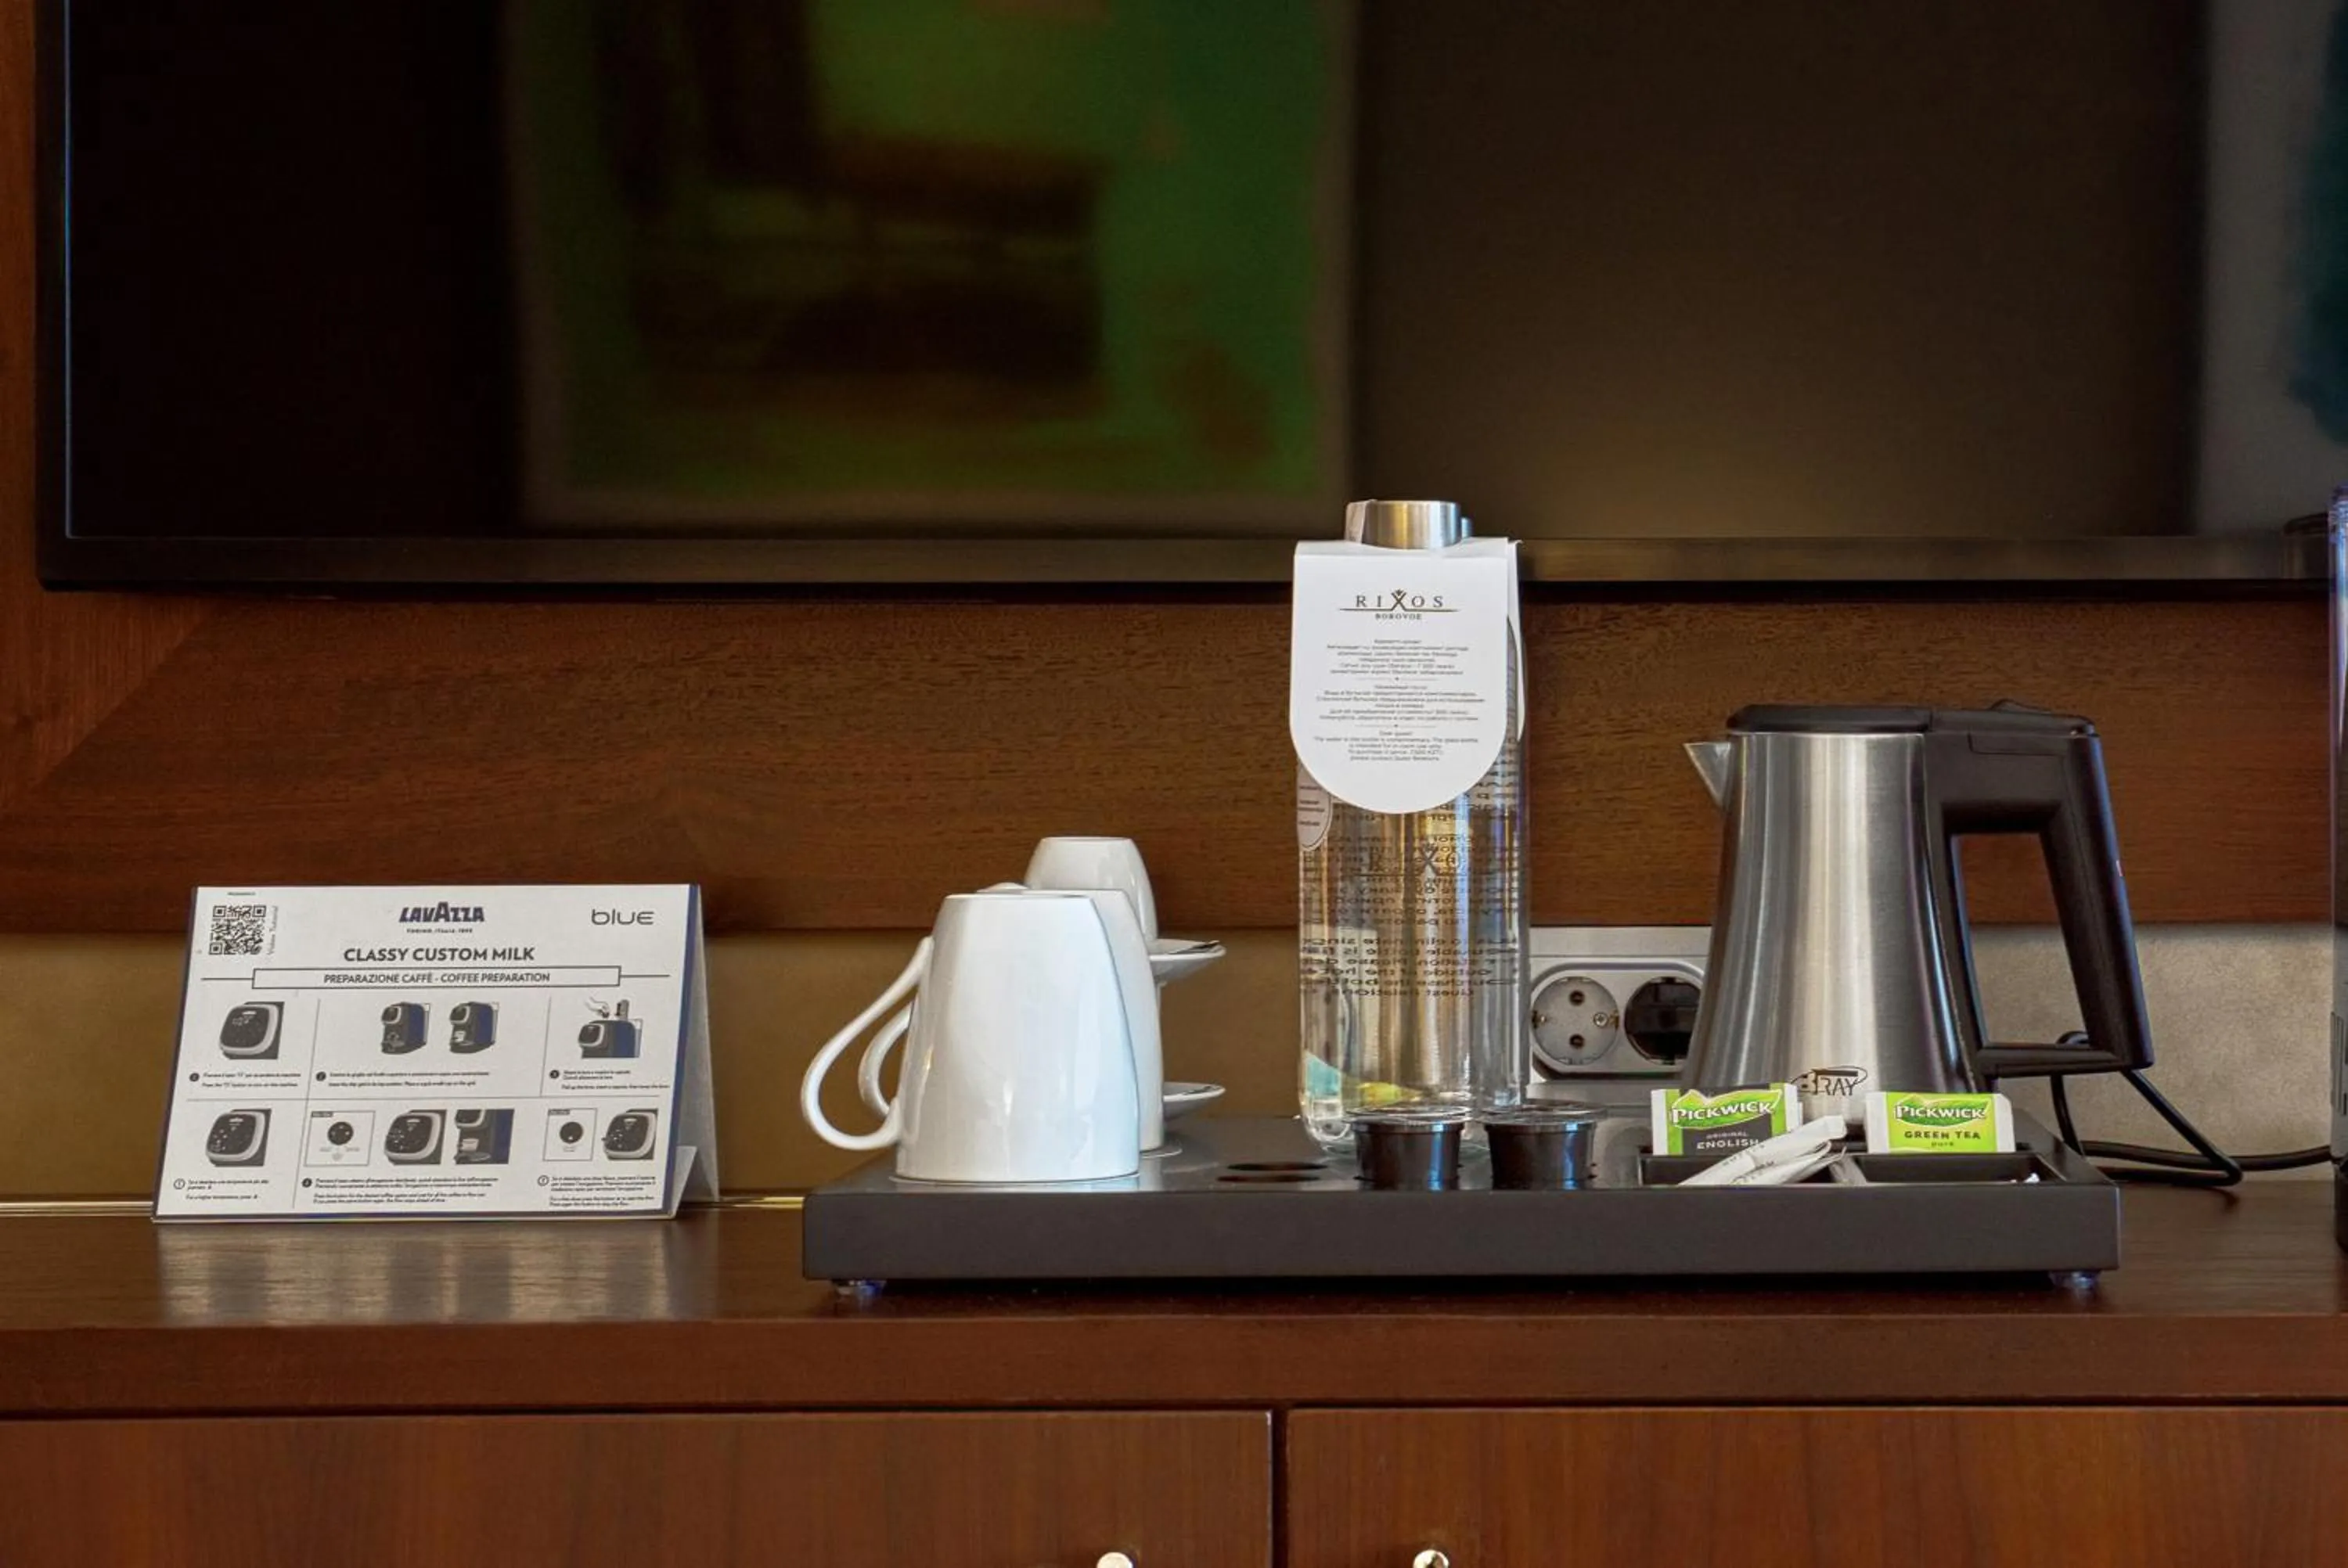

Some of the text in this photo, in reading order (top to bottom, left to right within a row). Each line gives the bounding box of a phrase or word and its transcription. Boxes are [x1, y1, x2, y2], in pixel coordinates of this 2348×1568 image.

[1356, 589, 1443, 610] RIXOS
[398, 901, 485, 922] LAVAZZA
[591, 908, 655, 926] blue
[343, 947, 535, 962] CLASSY CUSTOM MILK
[323, 974, 400, 984] PREPARAZIONE
[441, 973, 481, 983] COFFEE
[482, 972, 550, 983] PREPARATION
[1671, 1101, 1774, 1124] PICKWICK
[1896, 1105, 1985, 1119] PICKWICK
[1903, 1131, 1982, 1140] GREEN TEA
